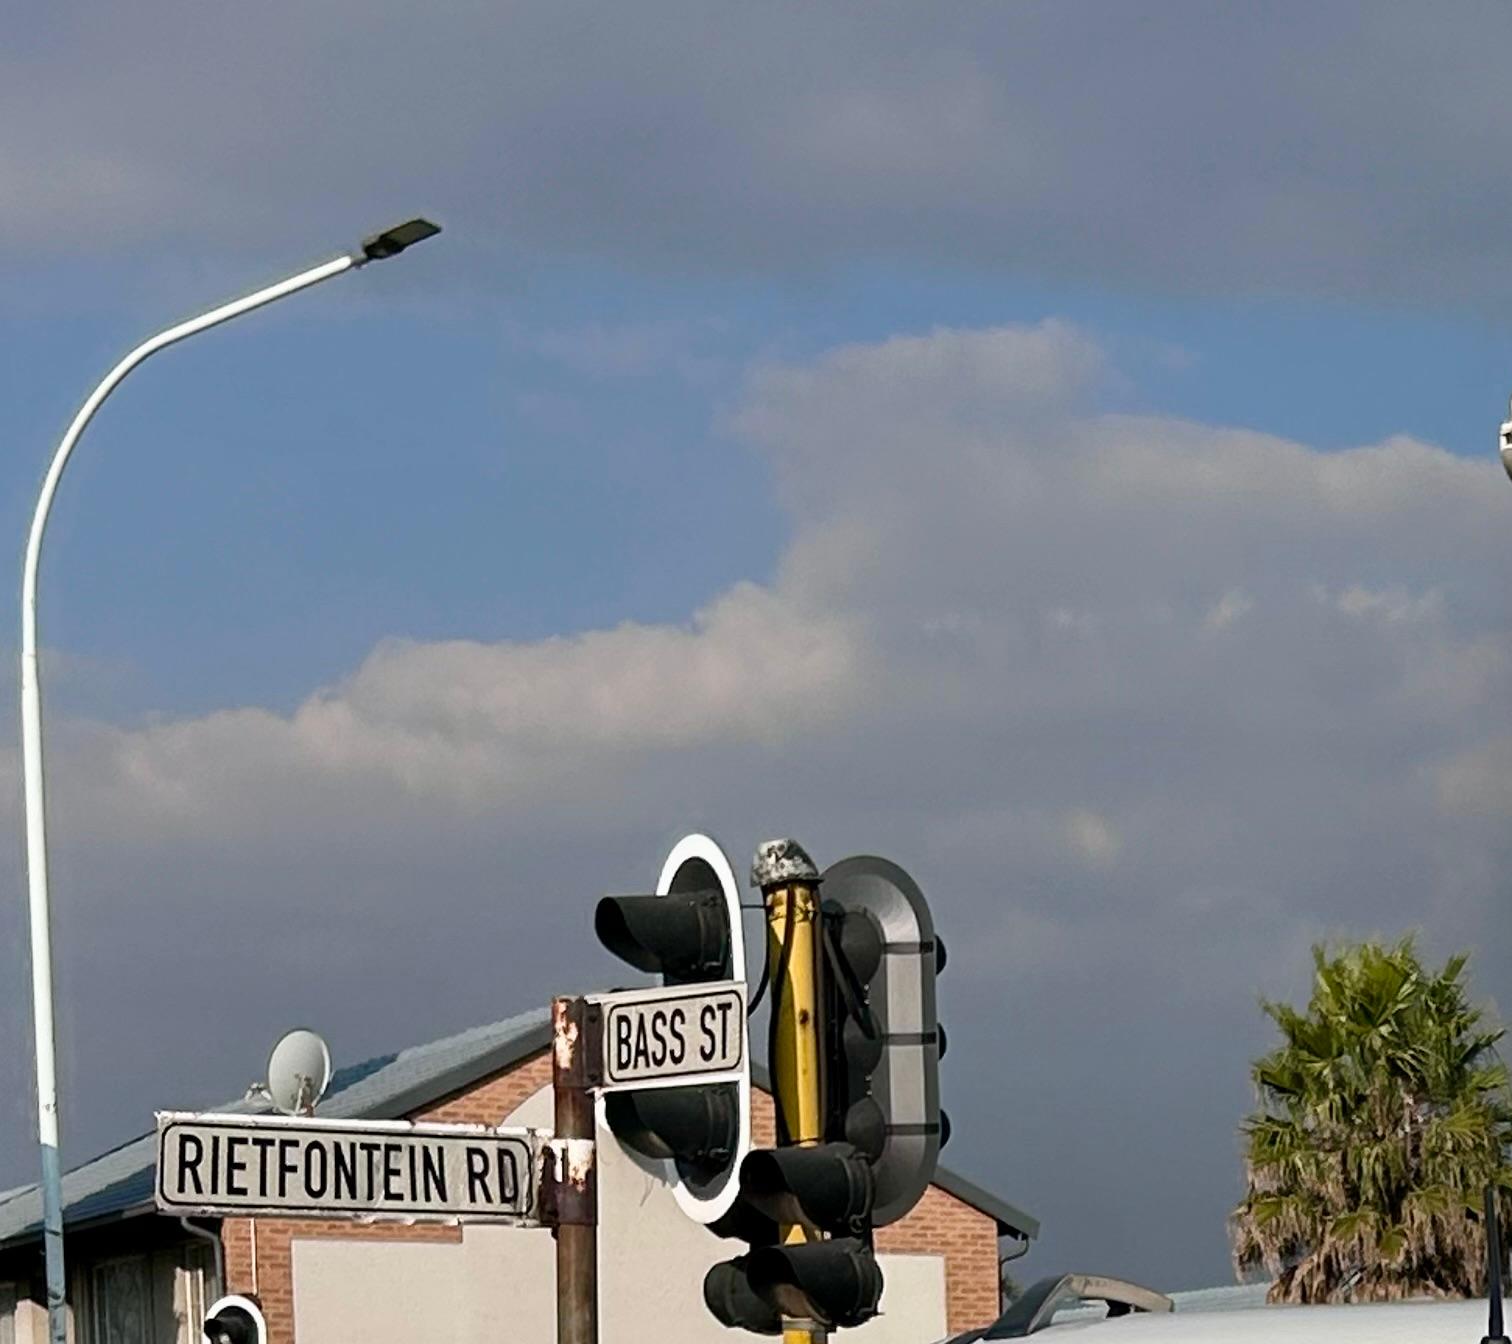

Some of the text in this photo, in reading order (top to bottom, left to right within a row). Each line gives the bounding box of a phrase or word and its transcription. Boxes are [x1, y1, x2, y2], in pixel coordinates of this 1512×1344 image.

[616, 1002, 733, 1071] BASS ST
[177, 1133, 520, 1206] RIETFONTEIN RD
